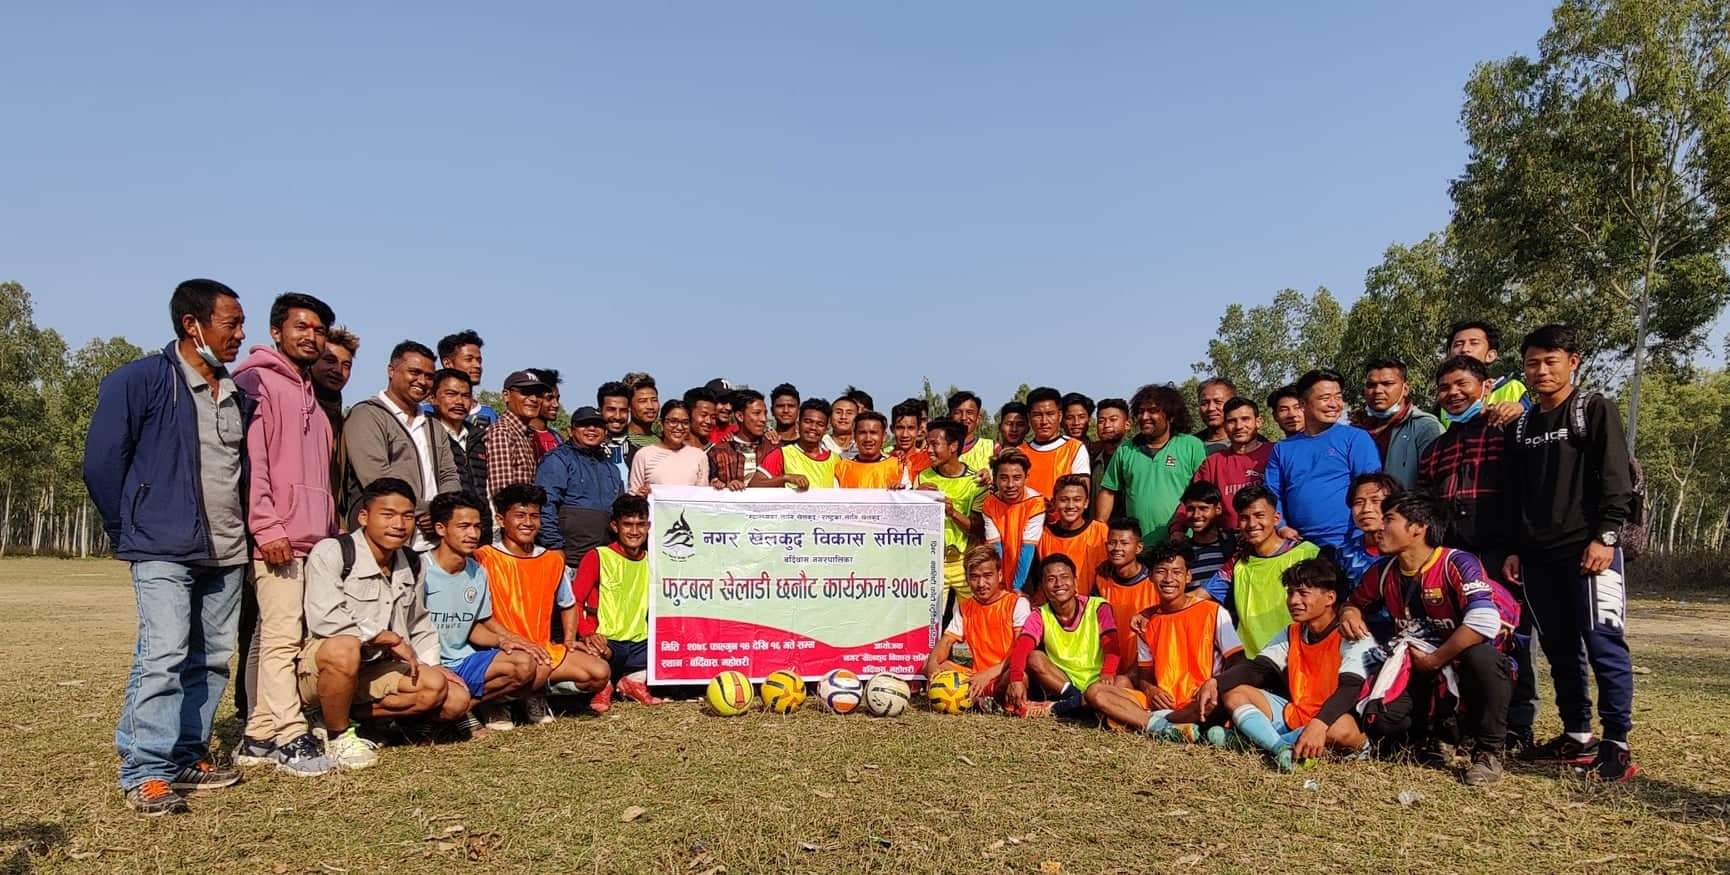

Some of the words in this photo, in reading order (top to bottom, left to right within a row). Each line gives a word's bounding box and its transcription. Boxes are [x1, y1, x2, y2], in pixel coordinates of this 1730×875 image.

[1525, 428, 1568, 445] POLICE
[703, 532, 740, 547] नगर
[748, 528, 804, 550] खेलकुद
[813, 528, 865, 547] विकास
[874, 528, 924, 546] समिति
[662, 578, 713, 606] फुटबल
[719, 571, 770, 600] खेलाडी
[776, 570, 818, 599] छनौट
[1596, 568, 1624, 628] NIKE
[431, 611, 474, 622] TIHAD
